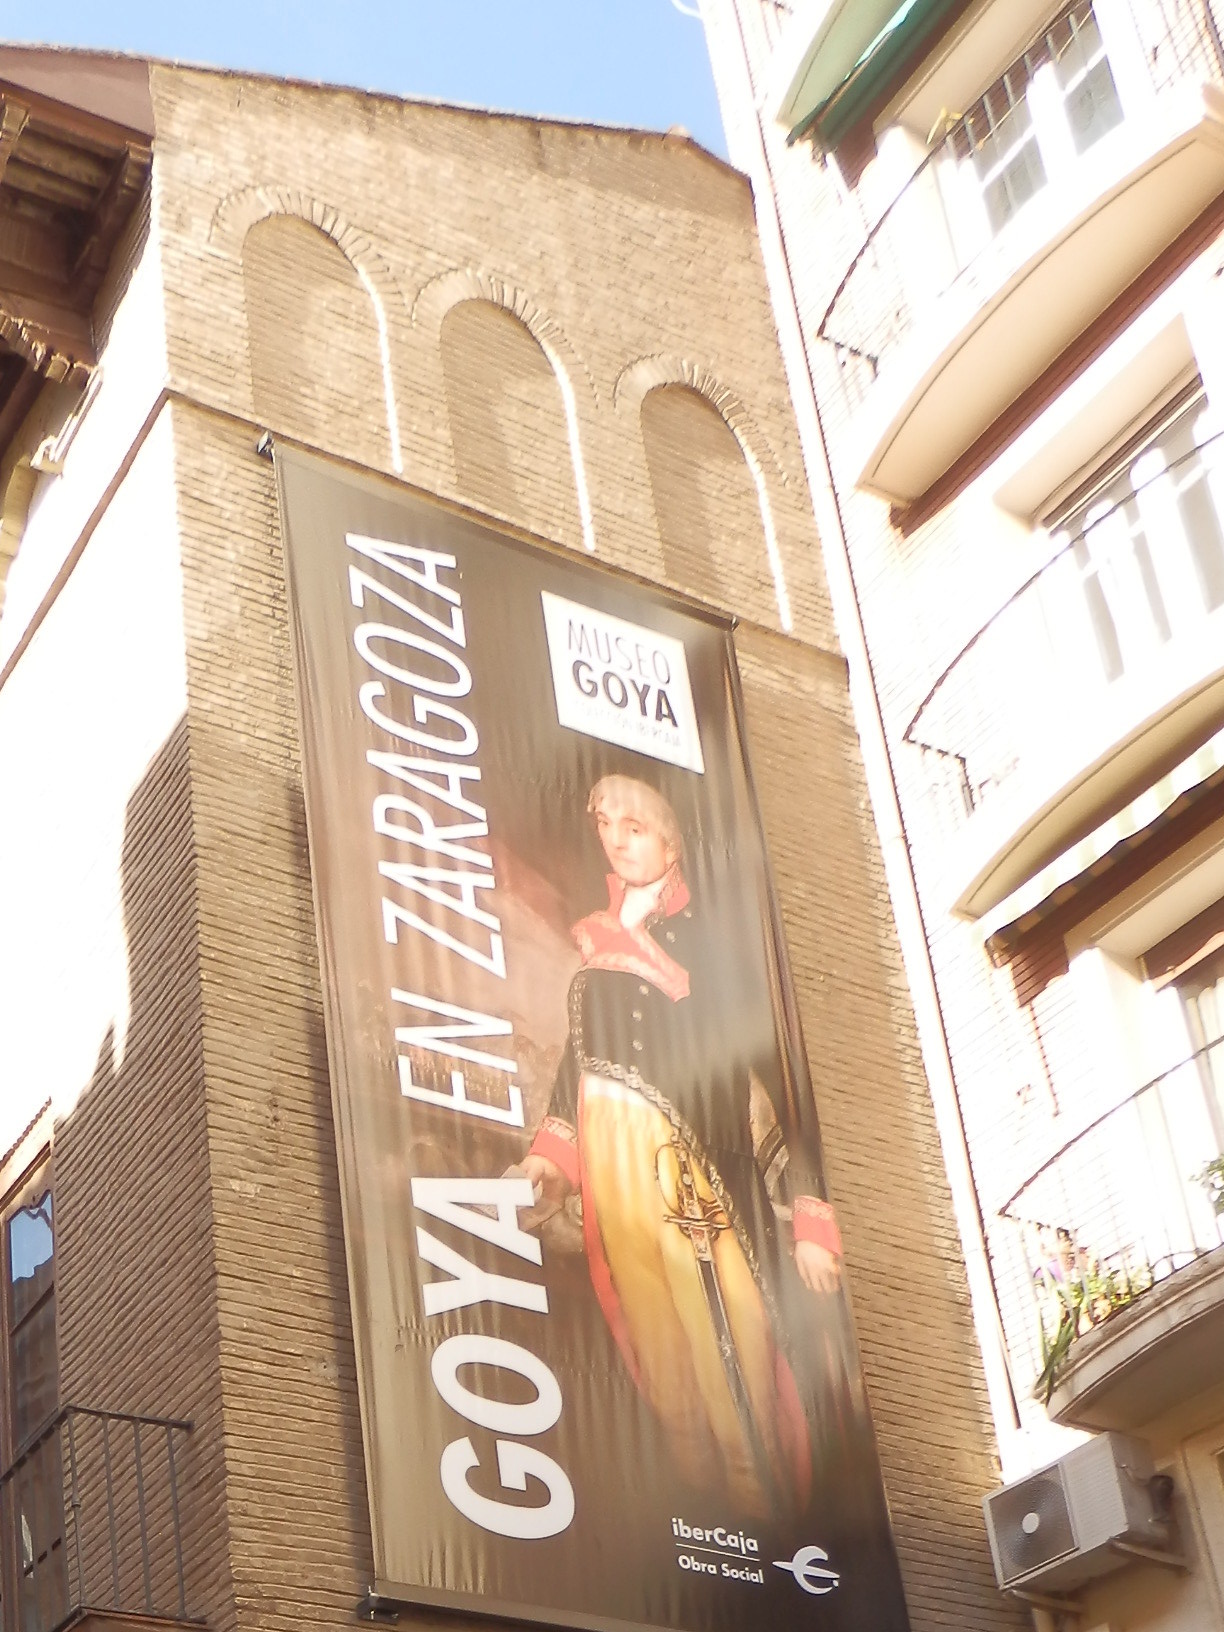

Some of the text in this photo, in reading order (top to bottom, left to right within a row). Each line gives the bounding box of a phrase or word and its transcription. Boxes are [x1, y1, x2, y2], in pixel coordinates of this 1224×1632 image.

[568, 619, 671, 685] MUSEO
[572, 659, 679, 728] GOYA
[345, 532, 575, 1539] GOYA EN ZARAGOZA
[672, 1517, 759, 1554] iberCaja
[678, 1554, 765, 1584] Obra Social
